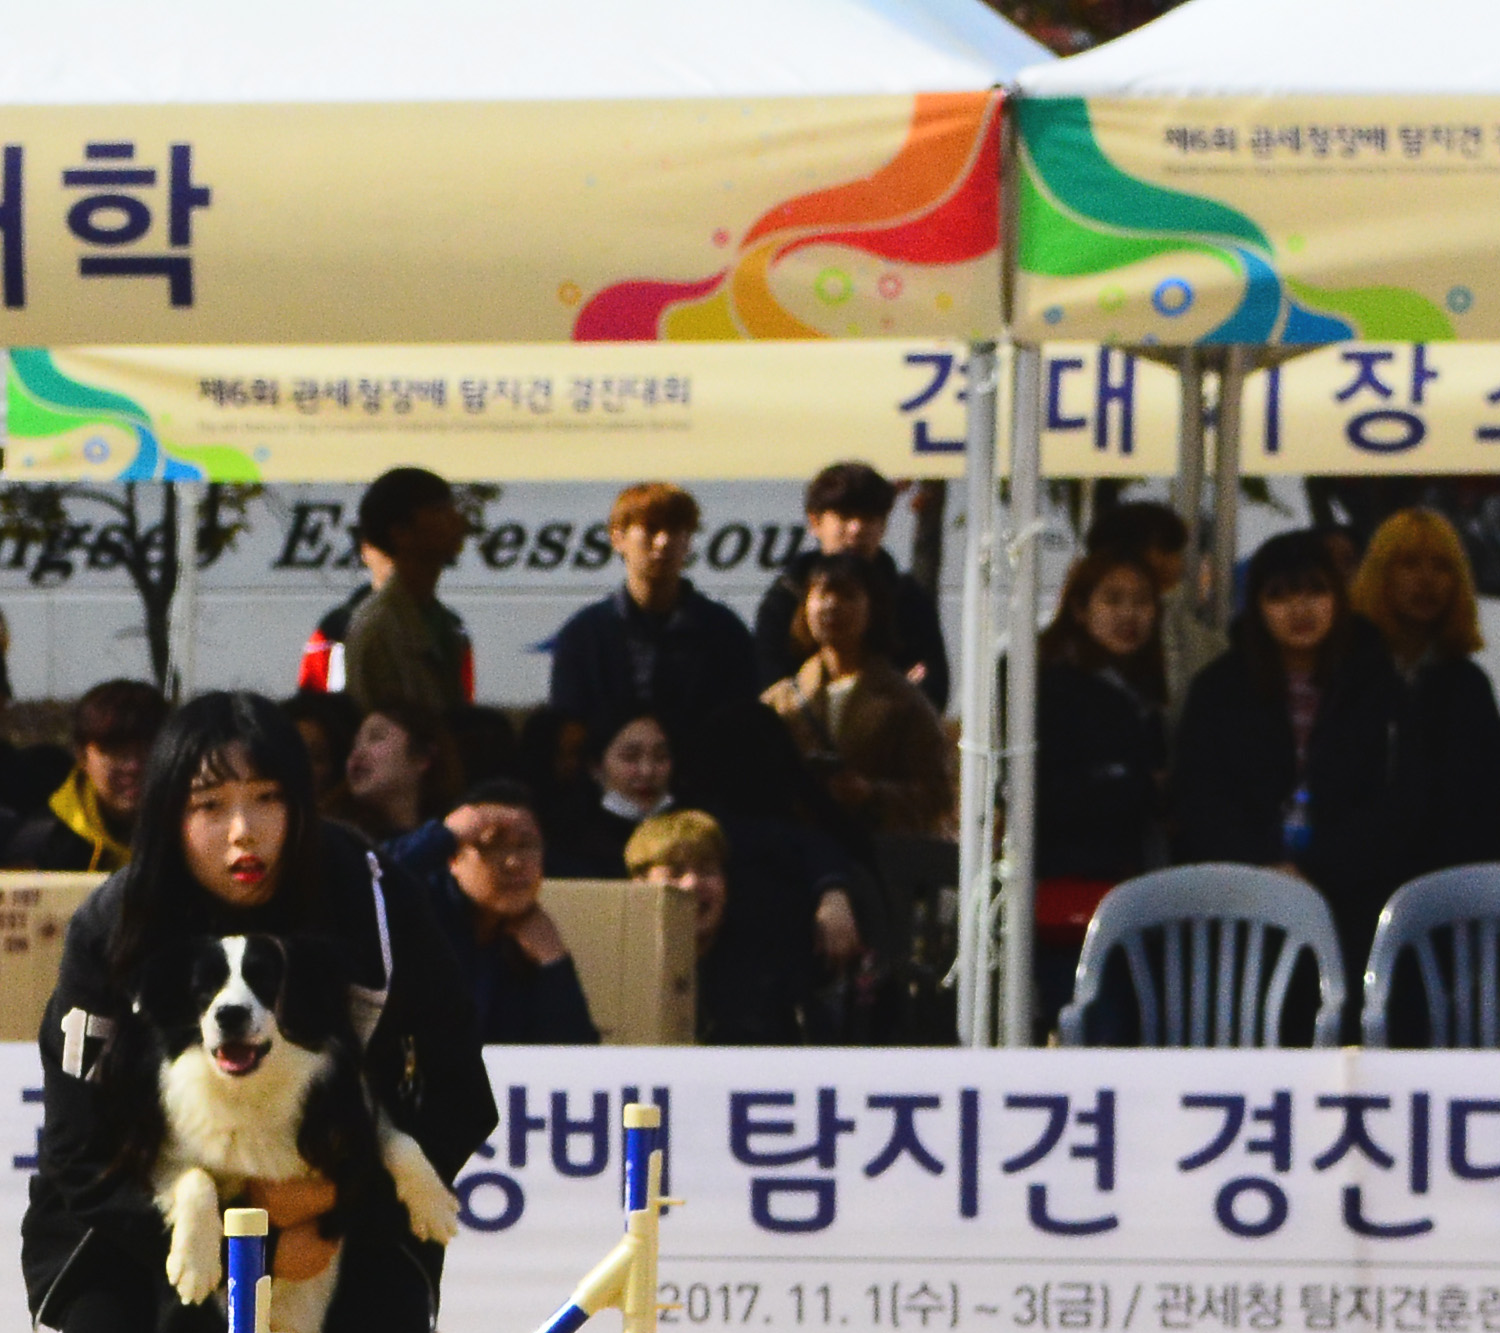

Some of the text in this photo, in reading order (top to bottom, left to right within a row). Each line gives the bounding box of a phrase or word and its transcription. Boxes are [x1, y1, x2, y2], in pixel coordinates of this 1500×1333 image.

[728, 1086, 1119, 1238] 탐지견
[866, 1279, 962, 1333] 1(수)
[1155, 1282, 1282, 1333] 관세청
